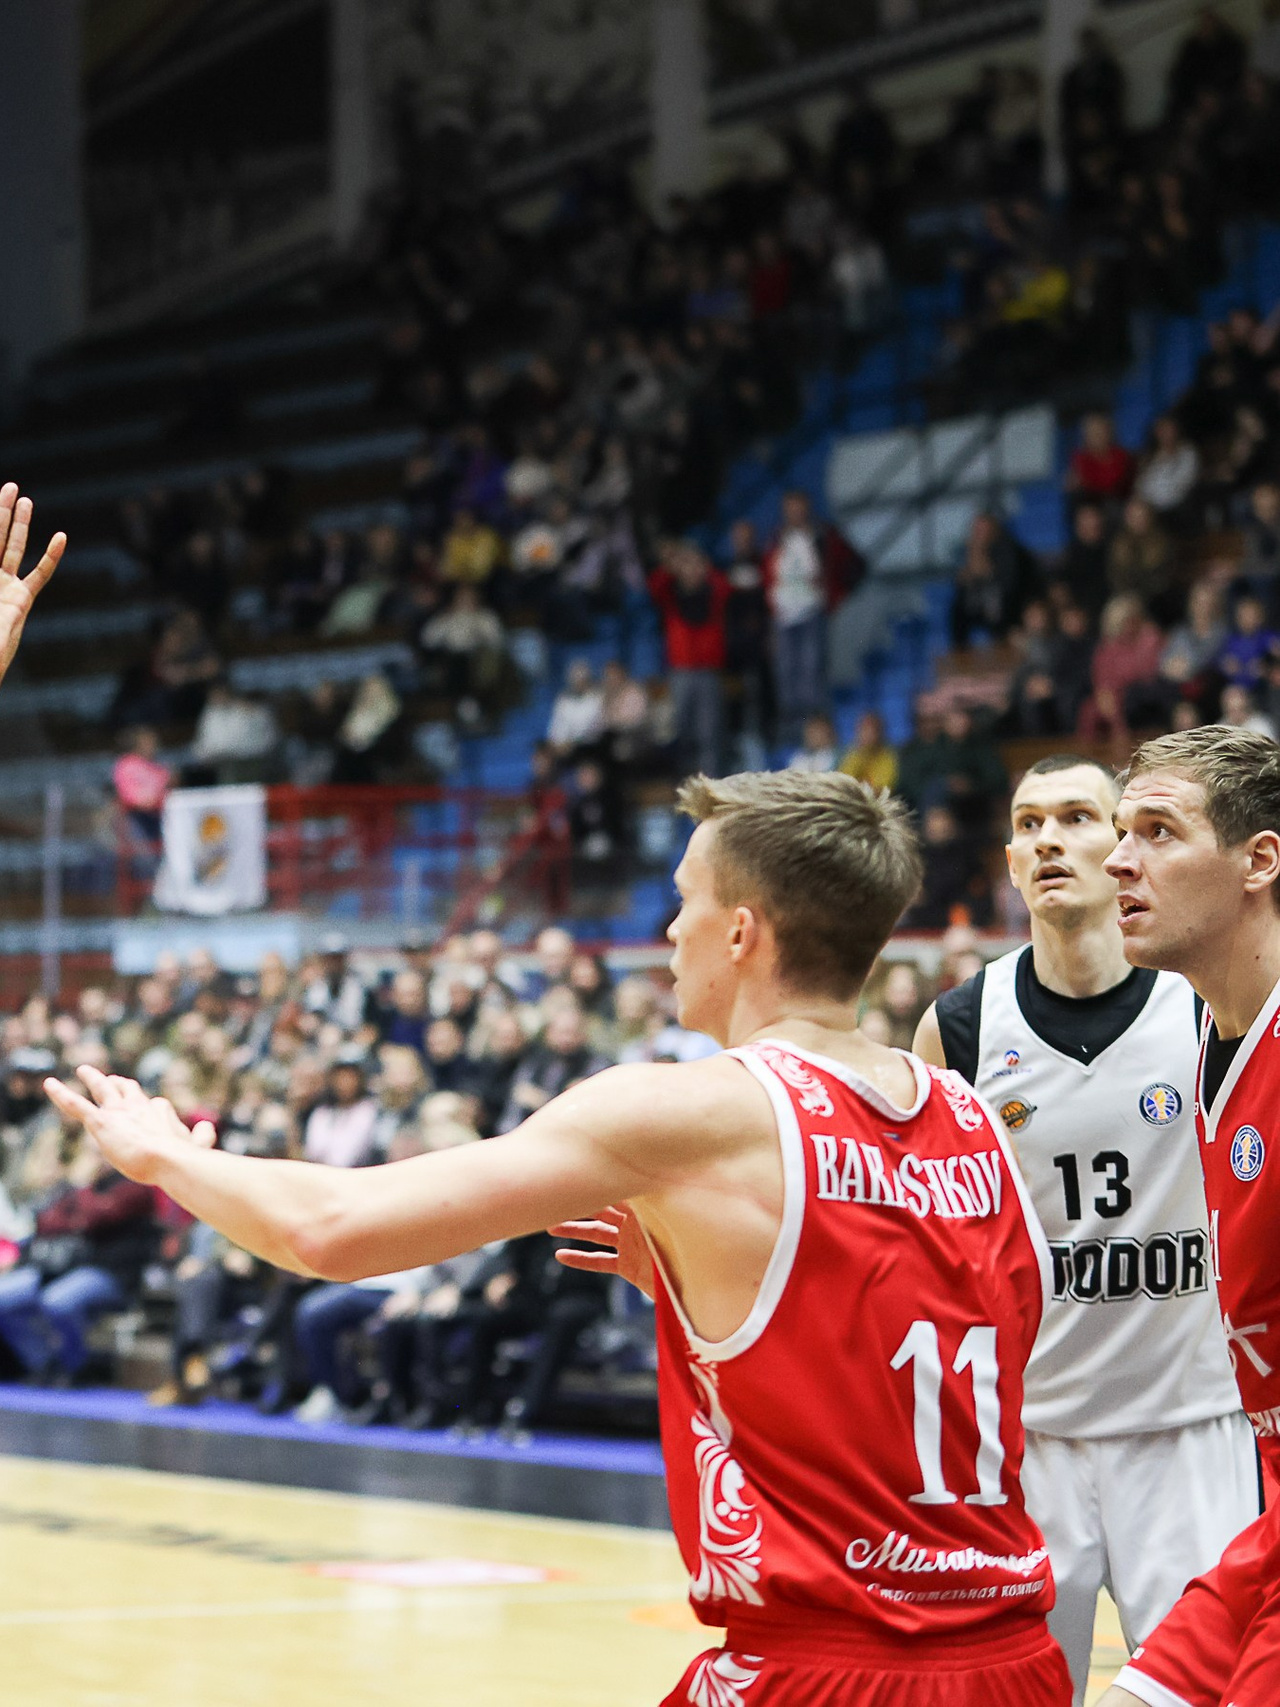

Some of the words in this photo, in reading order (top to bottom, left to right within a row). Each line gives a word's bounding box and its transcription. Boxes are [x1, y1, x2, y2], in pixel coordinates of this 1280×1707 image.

[1053, 1150, 1132, 1221] 13
[1047, 1228, 1209, 1303] TODOR
[888, 1320, 1009, 1506] 11
